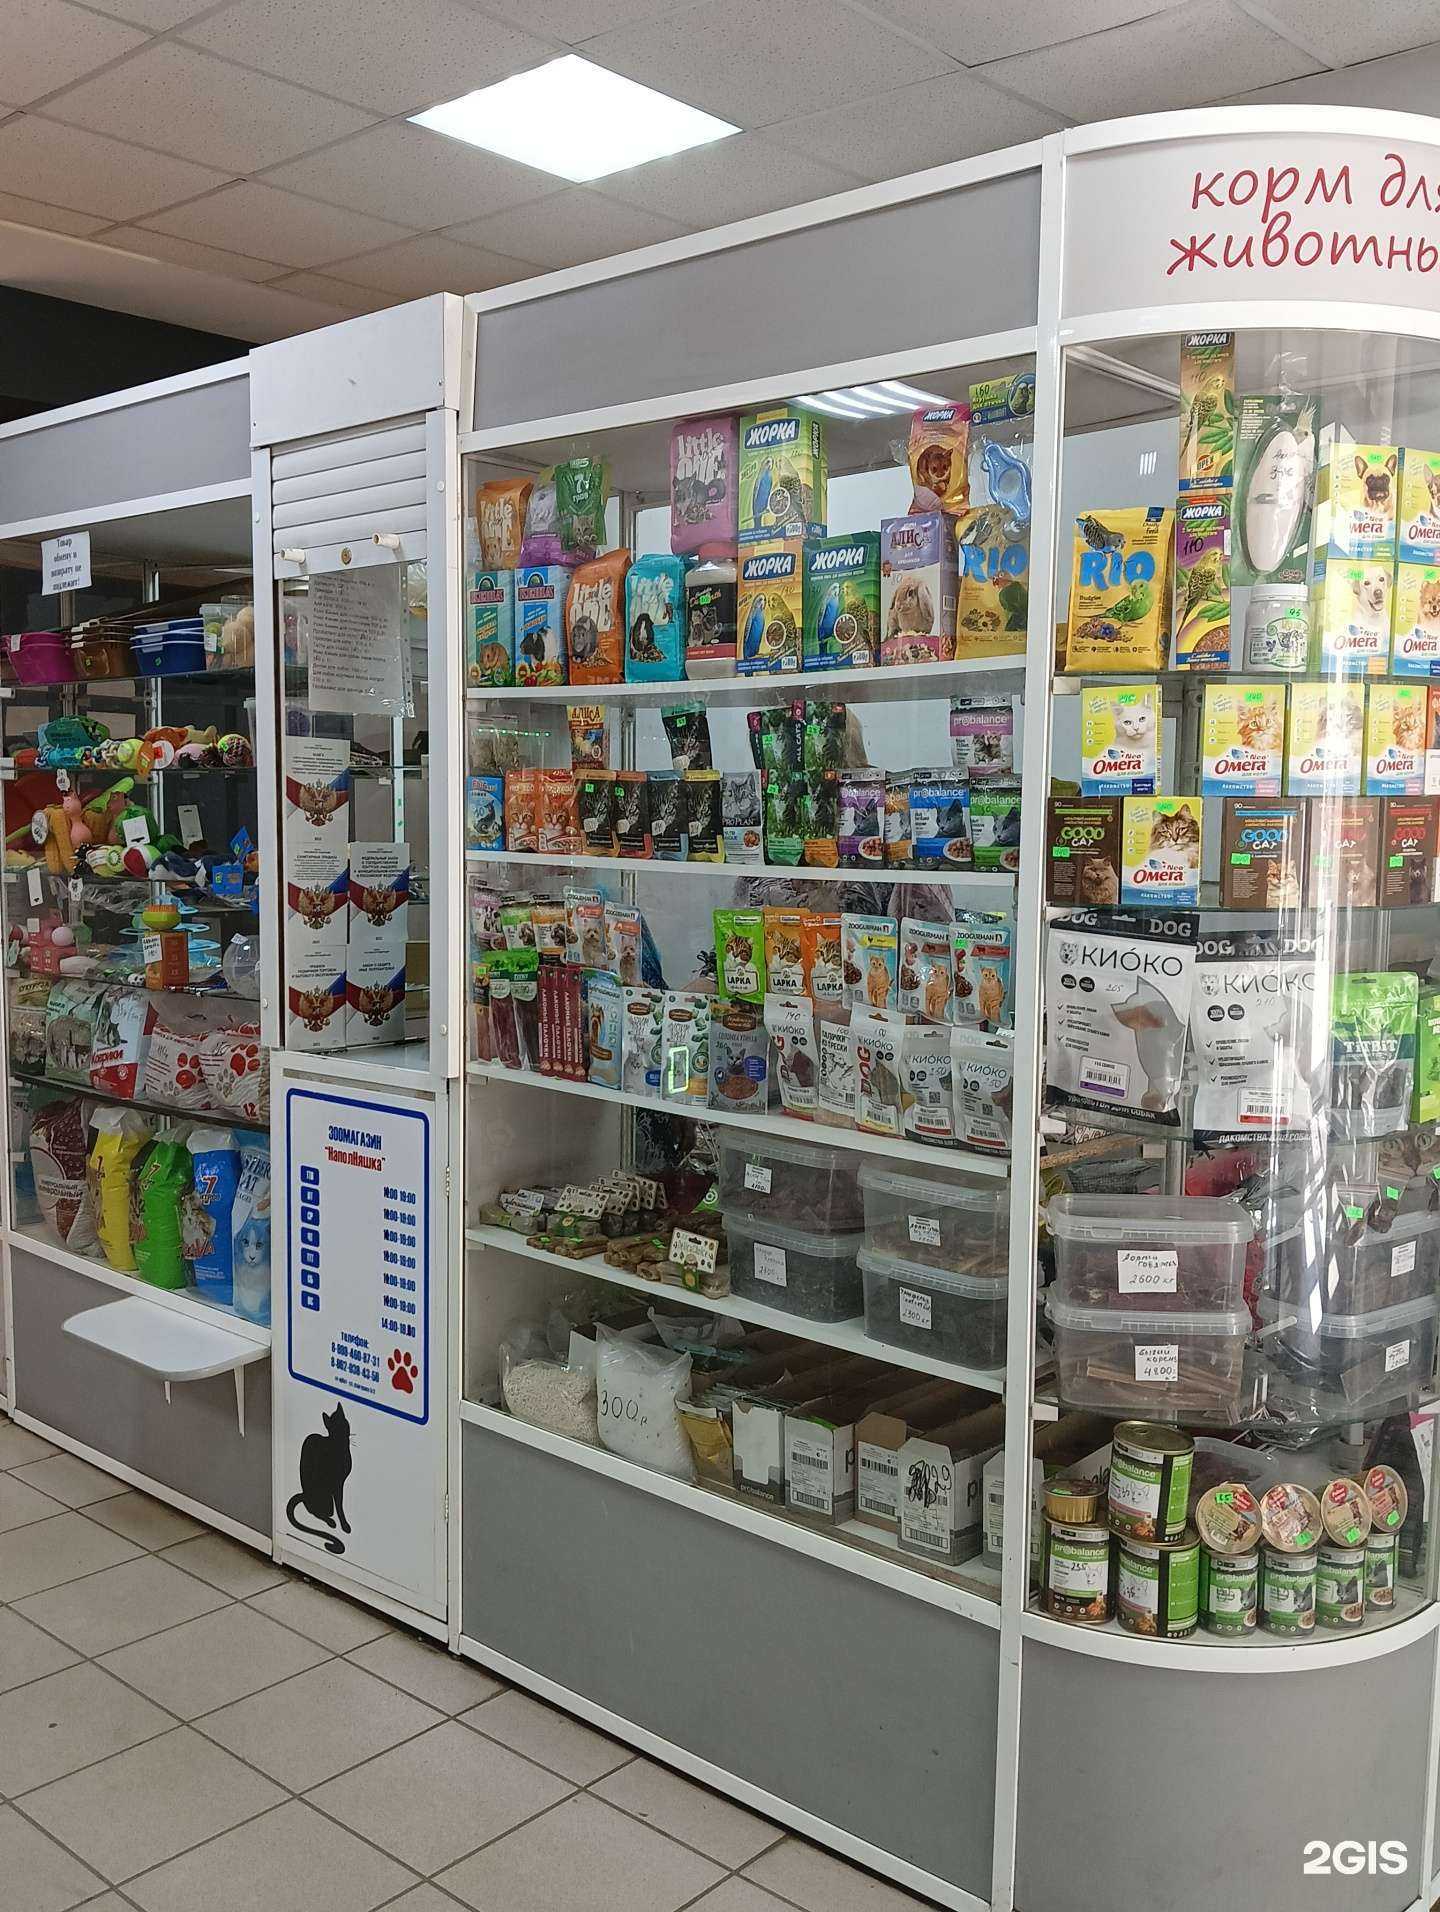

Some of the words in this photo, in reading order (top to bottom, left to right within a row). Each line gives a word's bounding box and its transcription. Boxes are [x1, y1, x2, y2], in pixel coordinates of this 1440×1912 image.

[1191, 165, 1352, 223] корм
[1186, 331, 1229, 347] ЖОРКА
[924, 408, 955, 421] ЖОРКА
[747, 421, 796, 446] ЖОРКА
[812, 422, 820, 458] ЖОРКА
[1182, 506, 1223, 518] ЖОРКА
[56, 537, 73, 549] Товар
[811, 546, 865, 572] ЖОРКА
[963, 544, 1028, 583] RIO
[745, 556, 793, 579] ЖОРКА
[1079, 551, 1156, 592] RIO
[1403, 638, 1438, 653] Омега
[953, 714, 1010, 727] probalance
[1092, 759, 1143, 776] Омега
[1214, 758, 1268, 775] Омега
[1300, 758, 1348, 774] Омега
[1376, 758, 1415, 774] Омега
[913, 787, 966, 798] probalance
[1061, 827, 1105, 840] GOOD
[1241, 829, 1289, 843] GOOD
[1071, 838, 1093, 848] CAT
[1252, 840, 1277, 850] CAT
[1335, 840, 1356, 849] CAT
[1401, 838, 1418, 848] CAT
[1133, 869, 1184, 883] Омега
[1149, 918, 1192, 938] DOG
[727, 975, 752, 985] LAPKA
[772, 977, 797, 988] LAPKA
[817, 981, 844, 992] LAPKA
[328, 1125, 382, 1150] ЗООМАГАЗИН
[1053, 1543, 1106, 1557] probalance
